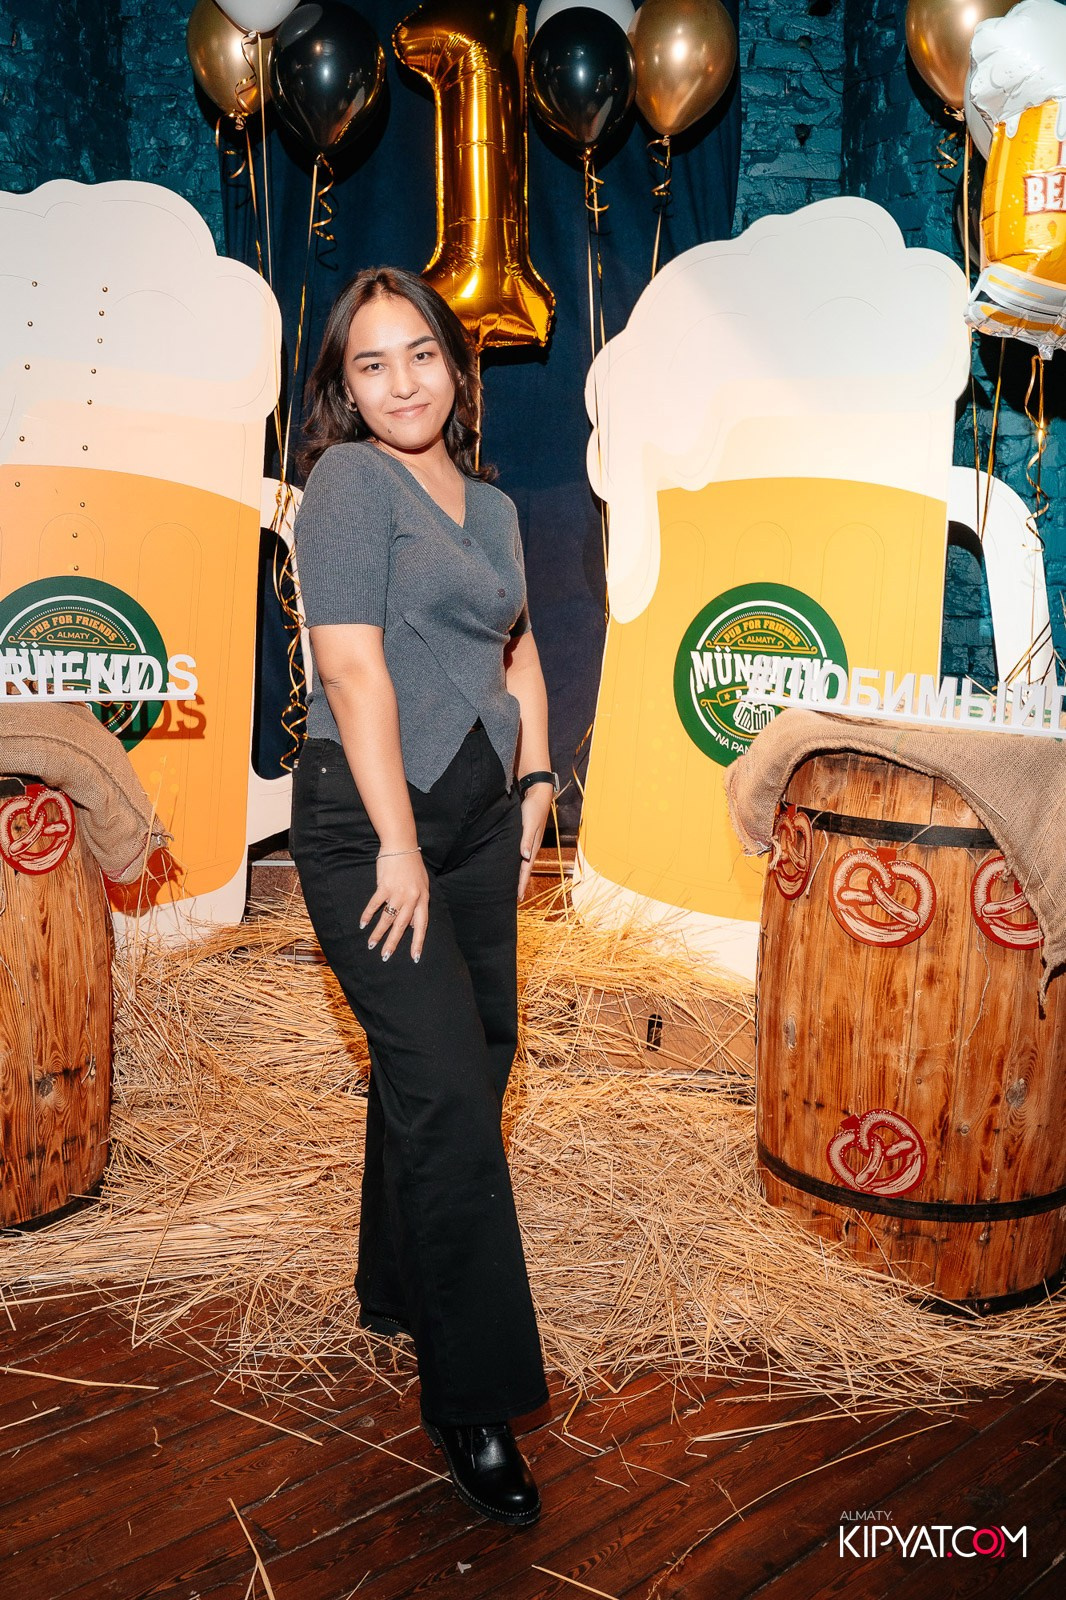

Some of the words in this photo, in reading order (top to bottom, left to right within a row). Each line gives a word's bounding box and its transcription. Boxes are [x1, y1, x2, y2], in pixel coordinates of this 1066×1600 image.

[1025, 174, 1066, 213] BE
[29, 620, 50, 637] PUB
[52, 615, 73, 626] FOR
[75, 615, 117, 641] FRIENDS
[57, 631, 90, 640] ALMATY
[723, 625, 742, 642] PUB
[743, 619, 761, 631] FOR
[763, 620, 801, 645] FRIENDS
[746, 636, 776, 644] ALMATY
[715, 733, 729, 749] NA
